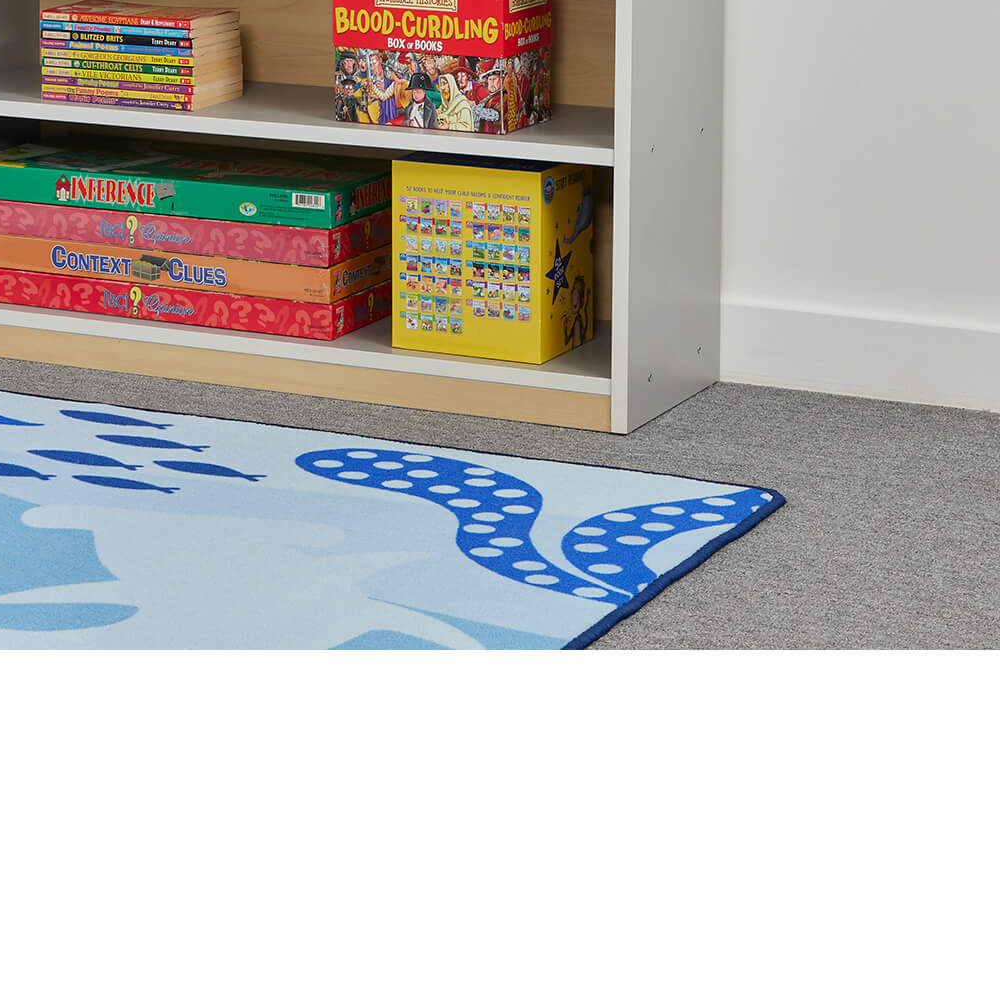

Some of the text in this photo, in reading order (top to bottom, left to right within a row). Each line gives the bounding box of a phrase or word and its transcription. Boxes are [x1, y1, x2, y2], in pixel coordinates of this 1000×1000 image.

[335, 7, 499, 44] BLOOD-CURDLING
[80, 32, 104, 42] BLITZED
[106, 34, 124, 43] BRITS
[388, 37, 406, 49] BOX
[414, 40, 443, 51] BOOKS
[82, 59, 143, 72] CUT-THROAT CELTS
[82, 70, 142, 81] VILE VICTORIANS
[71, 175, 156, 207] INFERENCE
